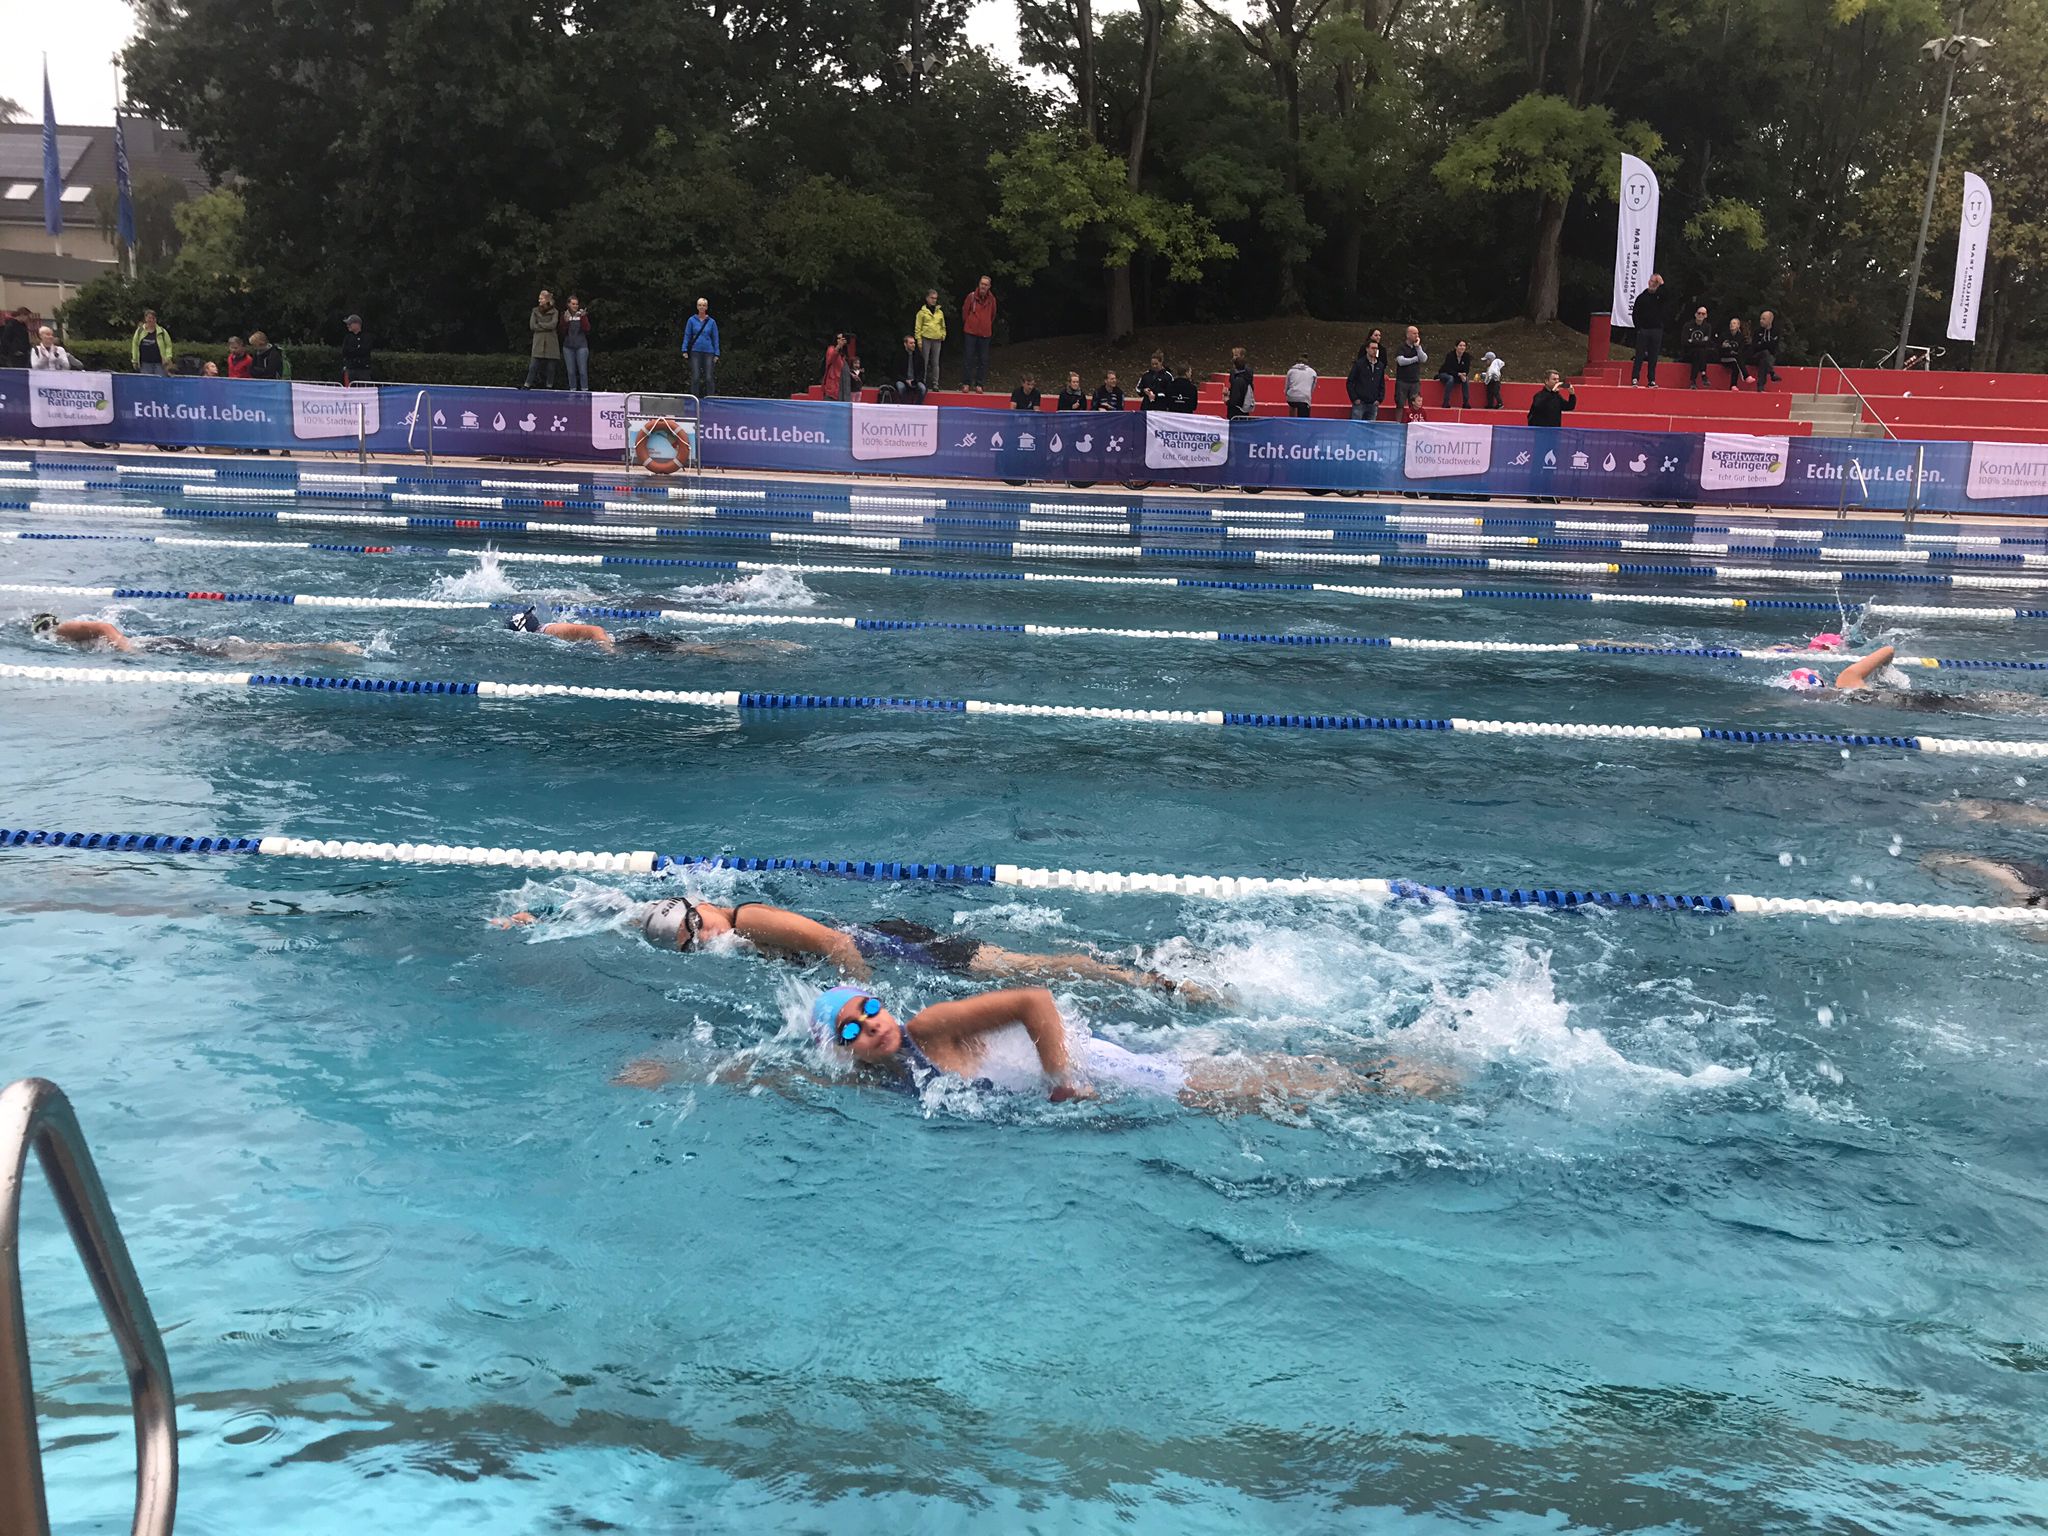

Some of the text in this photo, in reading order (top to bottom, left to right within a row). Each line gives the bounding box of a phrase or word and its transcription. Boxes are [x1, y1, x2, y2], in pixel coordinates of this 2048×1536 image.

[39, 388, 104, 401] Stadtwerke
[48, 398, 97, 409] Ratingen
[134, 400, 272, 422] Echt.Gut.Leben.
[326, 416, 371, 426] Stadtwee
[861, 422, 929, 437] KomMITT
[1156, 430, 1219, 442] Stadtwerke
[862, 437, 928, 448] 100% Stadtwerke
[1163, 439, 1211, 452] Ratingen
[1415, 440, 1482, 455] KomMITT
[1248, 442, 1384, 462] Echt.Gut.Leben.
[1712, 450, 1779, 462] Stadtwerke
[1415, 456, 1481, 466] 100% Stadtwerke
[1720, 460, 1768, 472] Ratingen
[1979, 460, 2048, 477] KomMITT
[1978, 476, 2047, 487] 100% Stadtwerke
